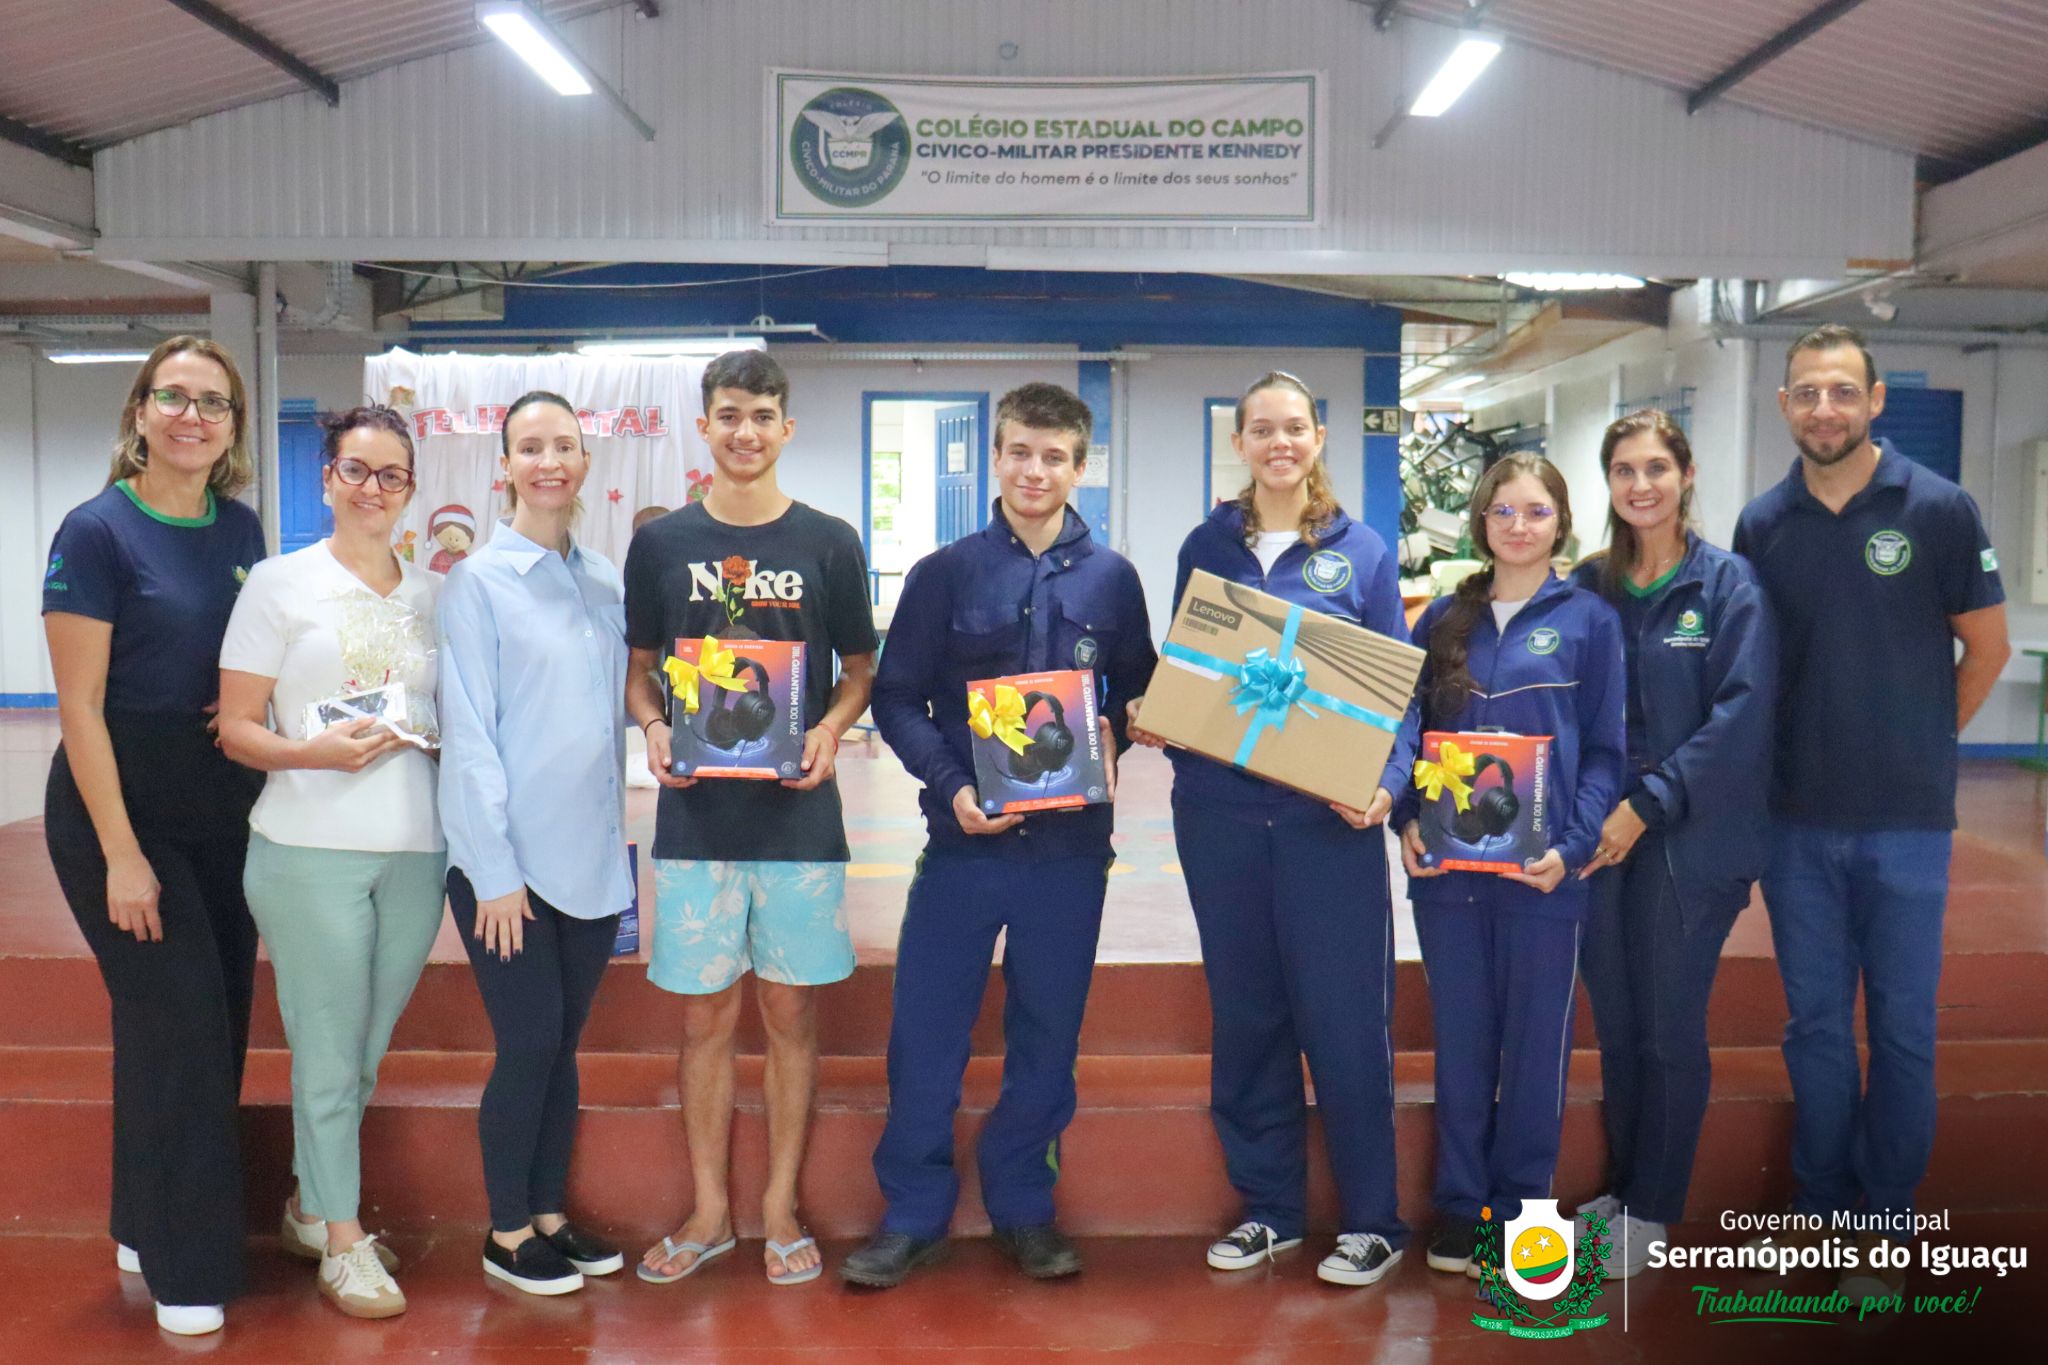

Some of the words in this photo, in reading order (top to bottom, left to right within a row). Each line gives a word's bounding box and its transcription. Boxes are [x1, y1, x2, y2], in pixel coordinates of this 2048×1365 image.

[916, 113, 1028, 138] COLÉGIO
[1034, 119, 1162, 138] ESTADUAL
[1168, 119, 1205, 138] DO
[1211, 118, 1304, 138] CAMPO
[916, 143, 1076, 160] CIVICO-MILITAR
[1082, 143, 1204, 160] PRESIDENTE
[1208, 143, 1303, 160] KENNEDY
[945, 170, 990, 185] limite
[995, 171, 1015, 185] do
[1020, 172, 1080, 186] homem
[1085, 171, 1095, 185] é
[1099, 175, 1109, 185] o
[1113, 171, 1158, 186] limite
[1163, 171, 1191, 185] dos
[1196, 174, 1229, 185] seus
[861, 181, 878, 195] DO
[411, 404, 510, 440] FELIZ
[574, 406, 669, 437] ATAL
[1192, 601, 1236, 624] Lenovo
[790, 659, 800, 706] QUANTUM
[789, 707, 799, 720] 100
[1083, 687, 1095, 732] QUANTUM
[789, 722, 798, 736] M2
[1089, 732, 1098, 745] 100
[1090, 747, 1099, 761] M2
[1534, 758, 1544, 803] QUANTUM
[1533, 804, 1542, 816] 100
[1532, 818, 1541, 832] M2
